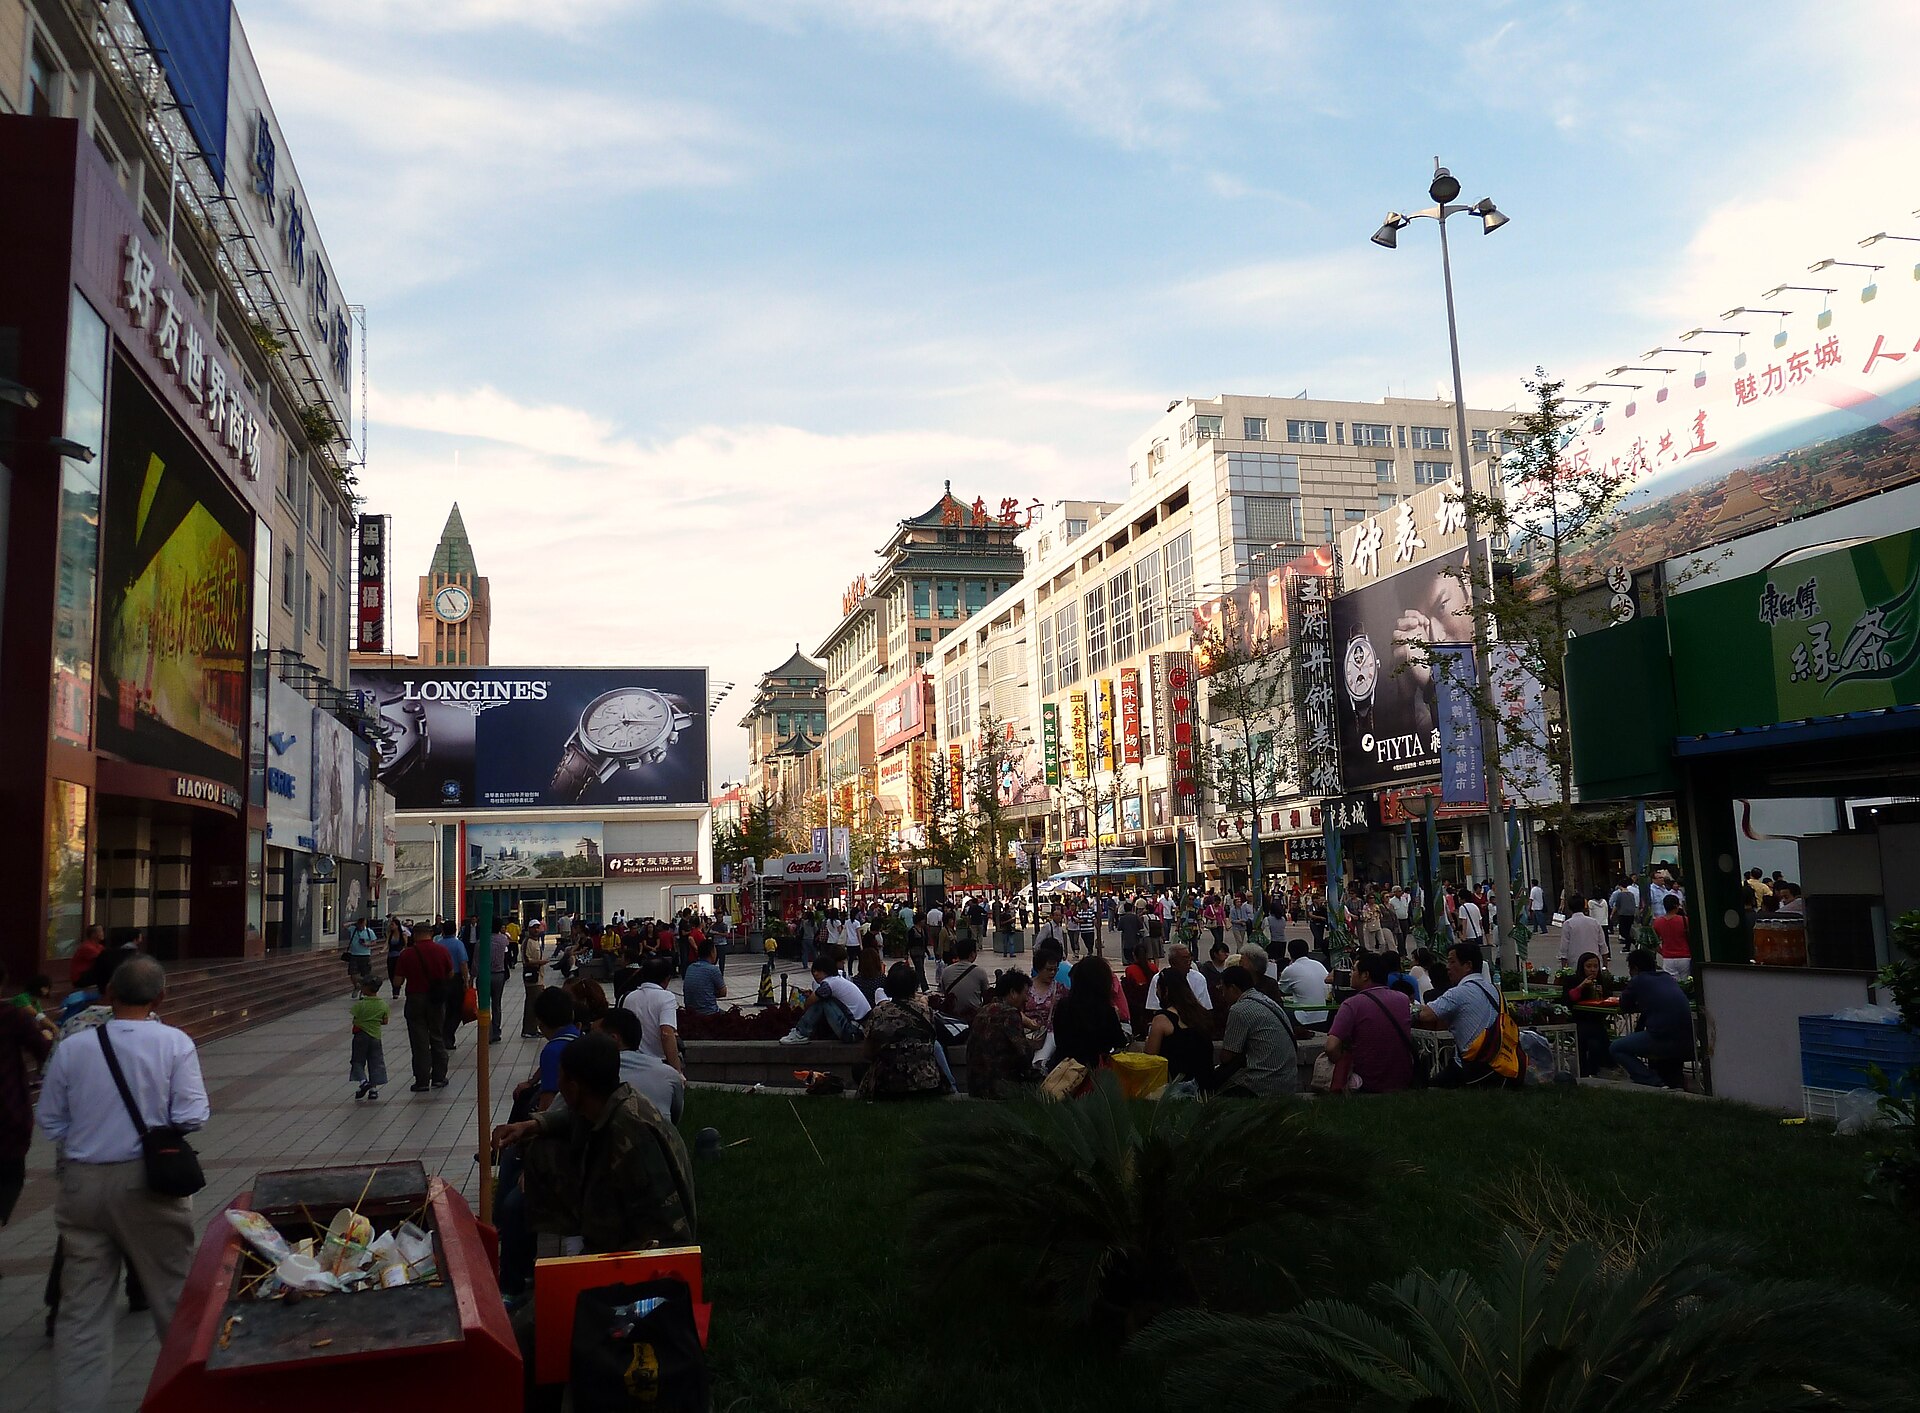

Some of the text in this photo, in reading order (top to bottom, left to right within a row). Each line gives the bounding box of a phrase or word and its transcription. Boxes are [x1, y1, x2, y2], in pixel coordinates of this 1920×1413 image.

[122, 234, 262, 481] 好友世界商场
[1734, 335, 1843, 407] 魅力东城
[403, 680, 548, 700] LONGINES
[1122, 685, 1139, 747] 珠宝广场
[1300, 577, 1341, 793] 王府井钟表城
[1376, 733, 1425, 763] FIYTA
[177, 777, 220, 802] HAOYOU
